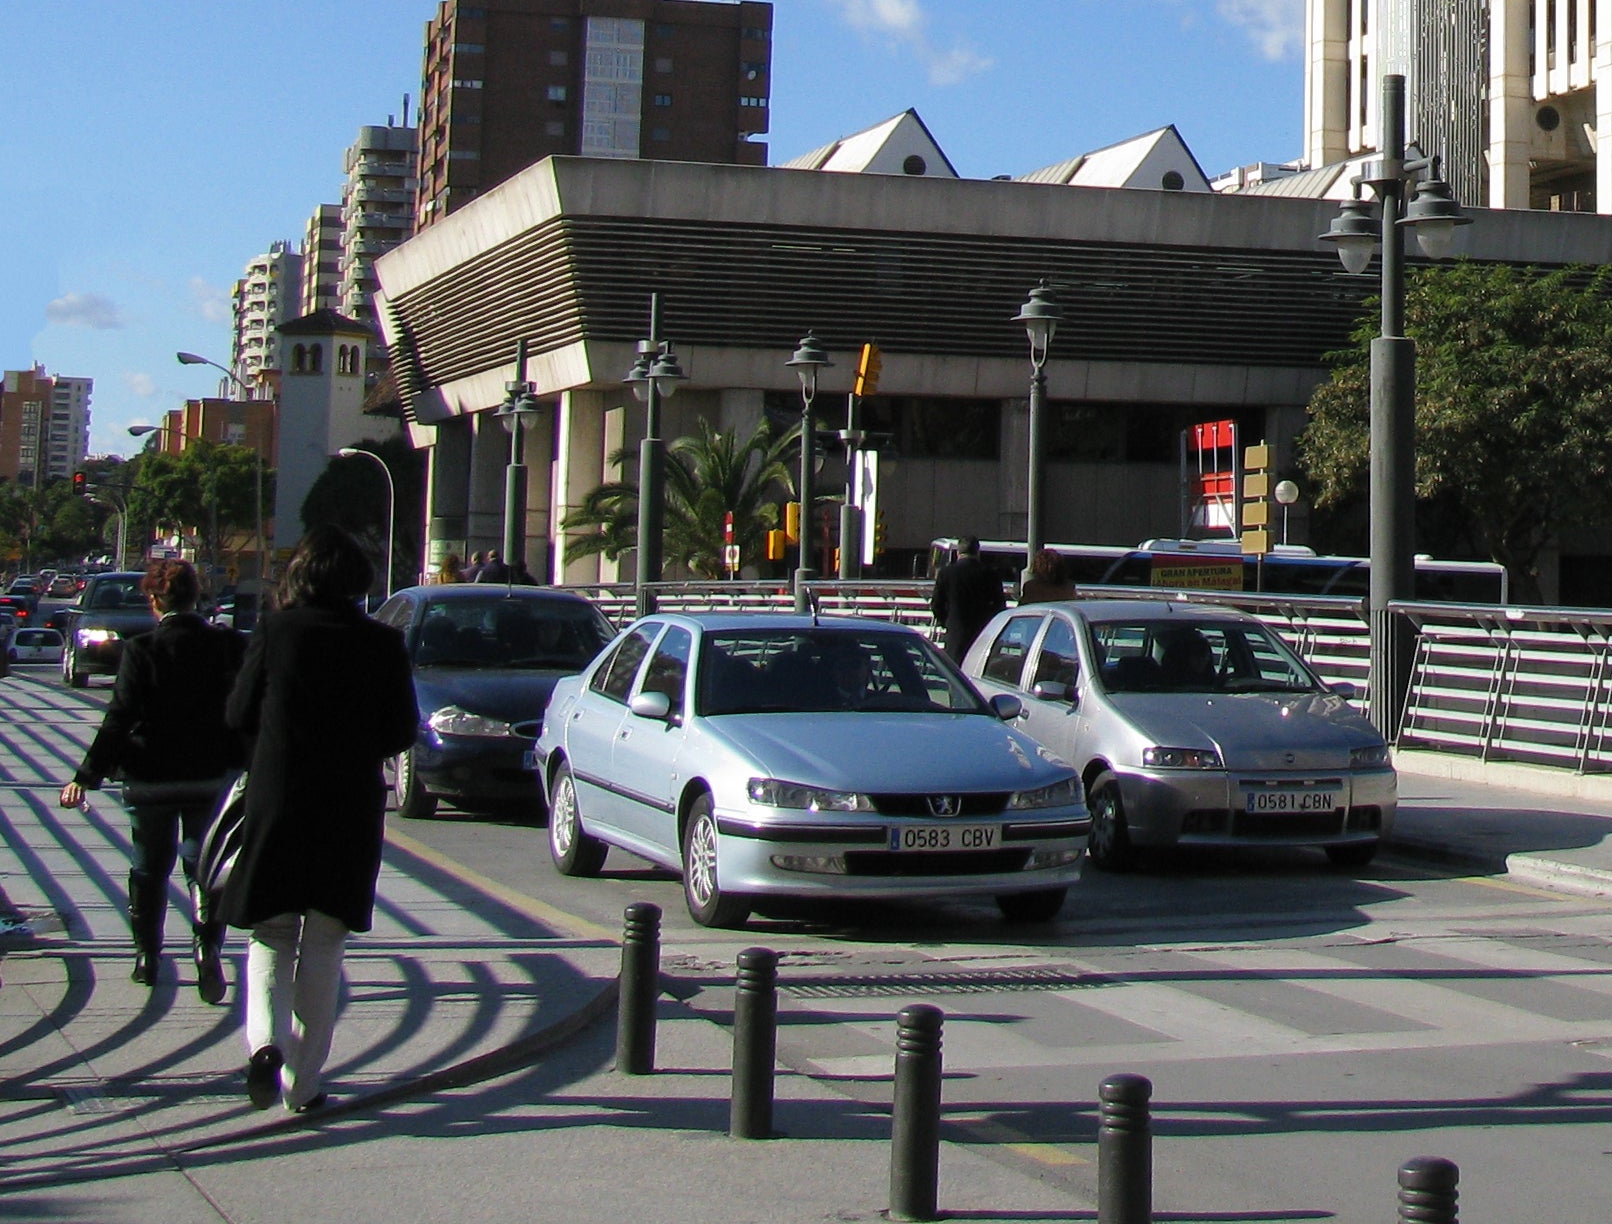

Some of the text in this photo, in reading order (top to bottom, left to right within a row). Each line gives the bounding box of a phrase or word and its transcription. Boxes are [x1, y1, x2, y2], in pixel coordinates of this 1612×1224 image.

[1161, 567, 1232, 577] GRAN APERTURA
[1258, 793, 1332, 810] 0581 CBN
[904, 828, 994, 848] 0583 CBV
